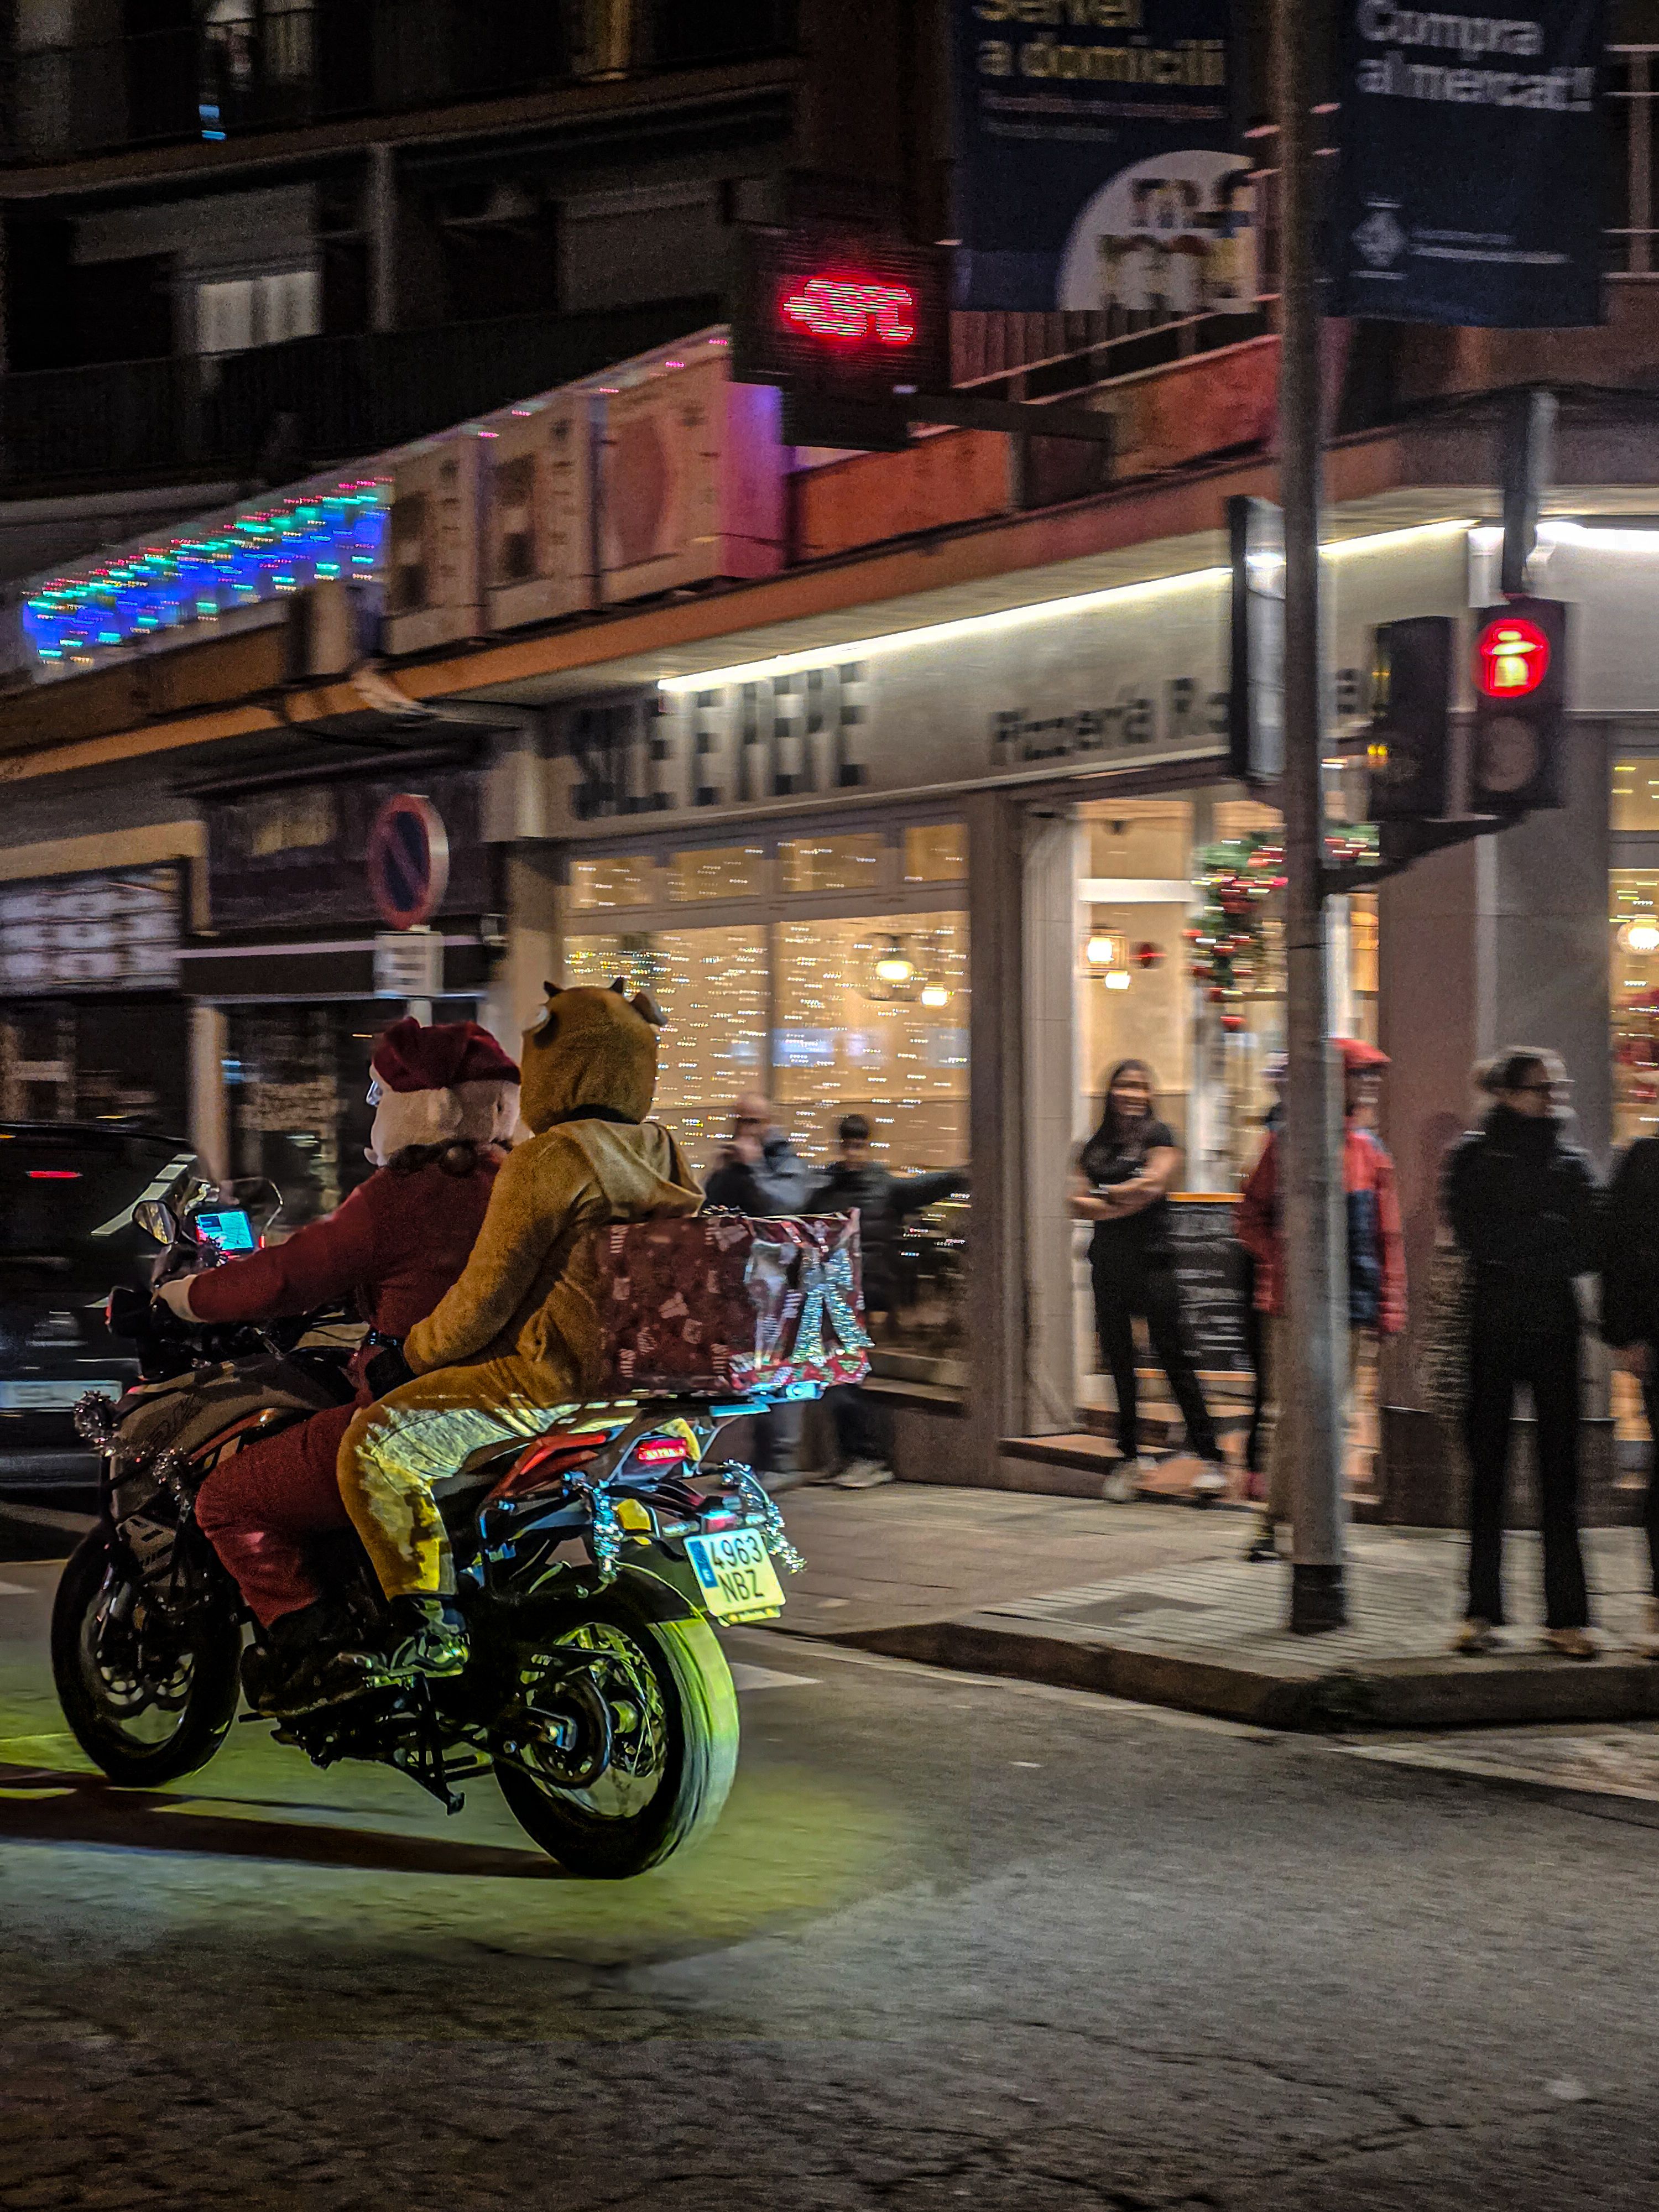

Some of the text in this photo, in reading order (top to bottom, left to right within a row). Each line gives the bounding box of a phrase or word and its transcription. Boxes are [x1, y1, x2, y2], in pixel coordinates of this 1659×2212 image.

[1357, 0, 1545, 61] Compra
[977, 40, 1012, 76] a
[710, 1535, 763, 1570] 4963
[718, 1568, 765, 1603] NBZ
